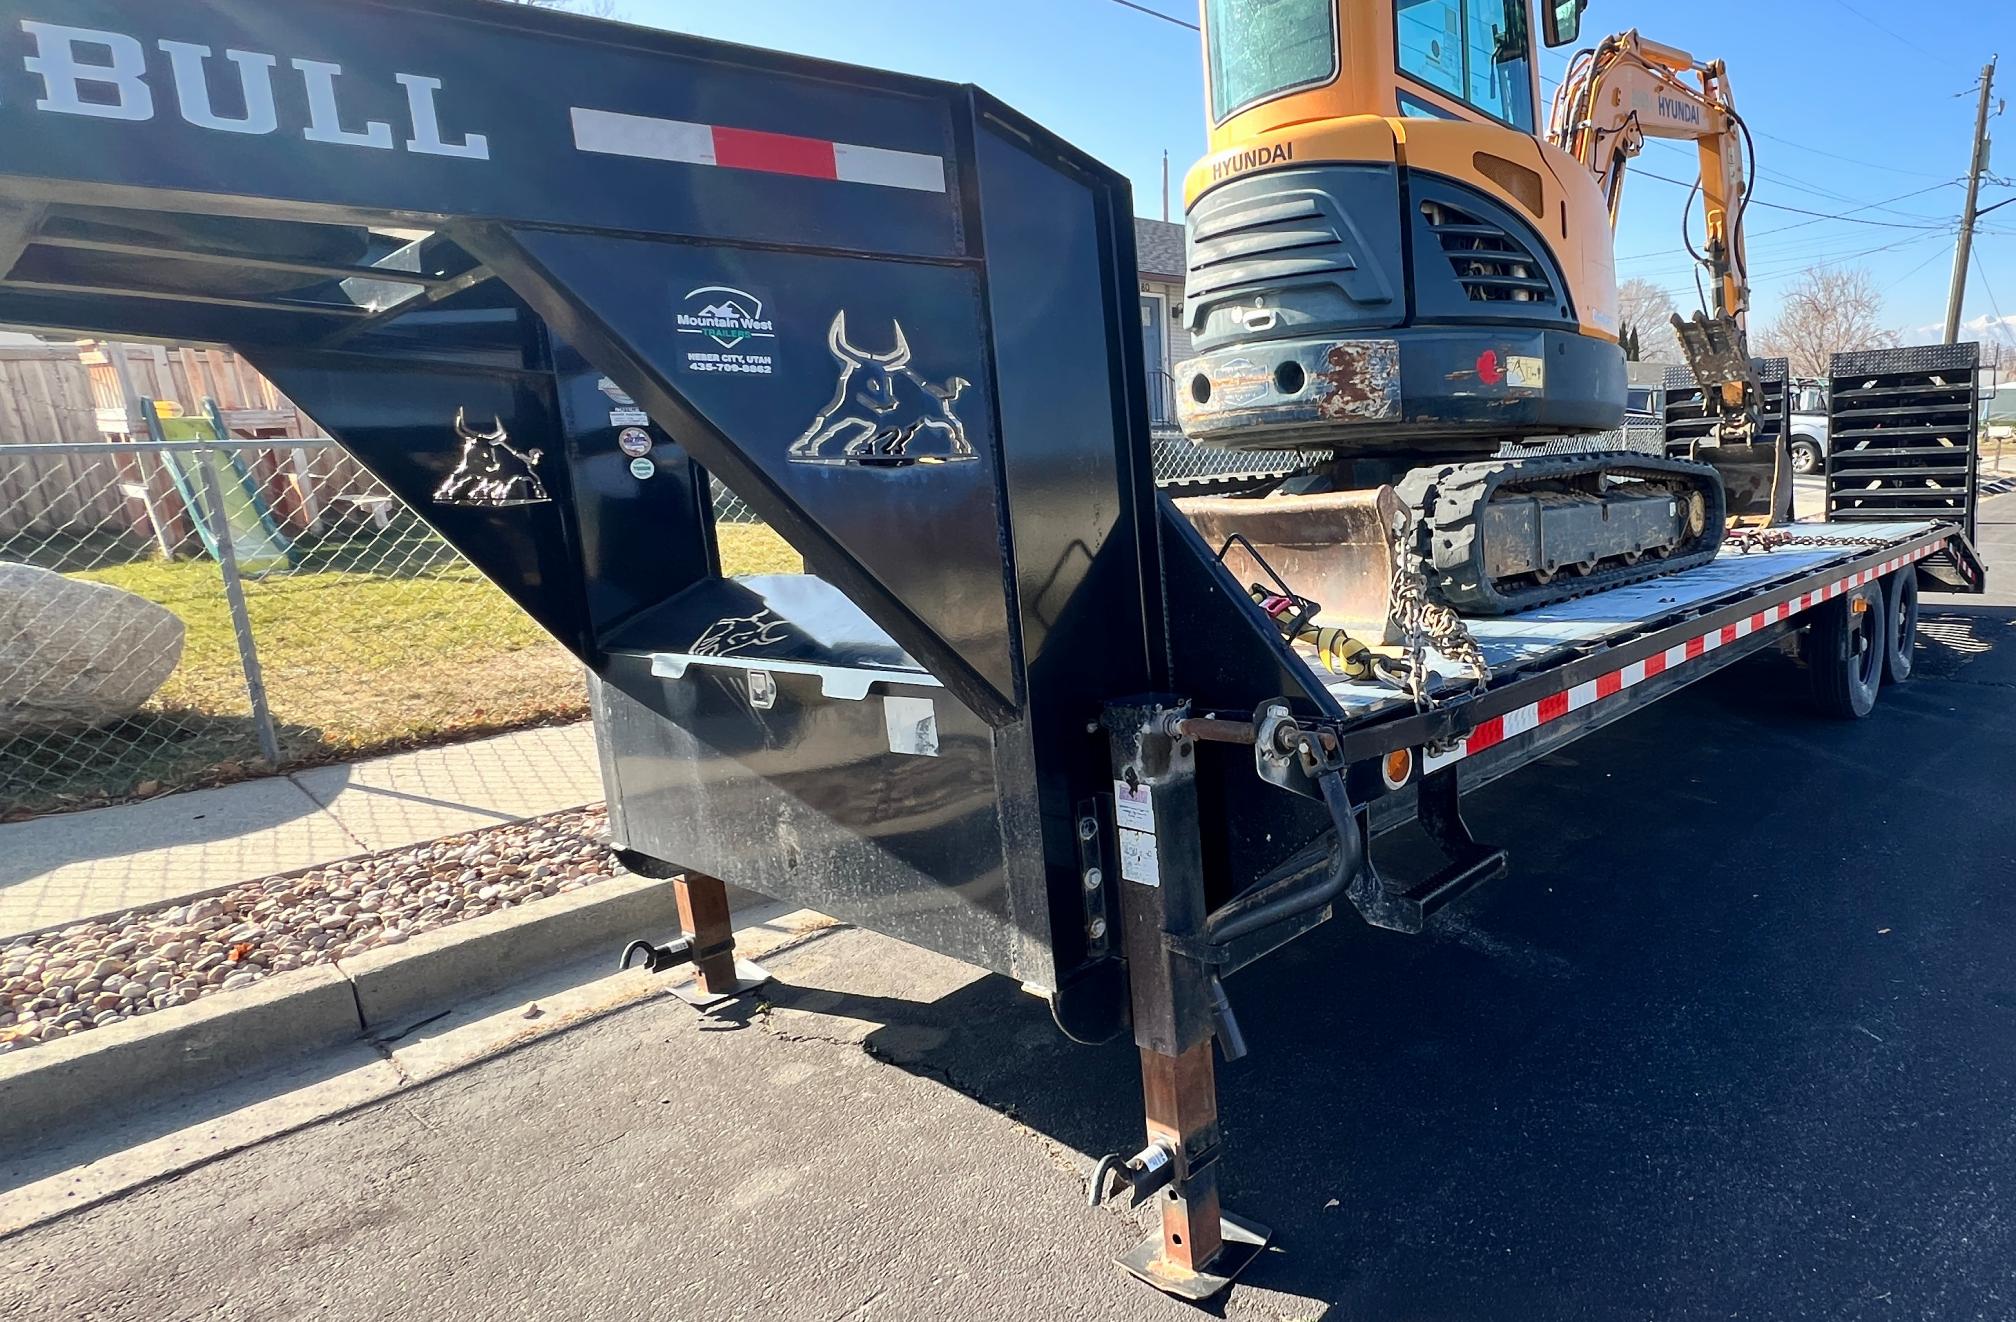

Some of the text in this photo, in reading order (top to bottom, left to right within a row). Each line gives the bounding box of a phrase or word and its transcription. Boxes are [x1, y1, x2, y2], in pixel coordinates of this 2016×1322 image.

[20, 18, 490, 161] BULL
[1658, 96, 1700, 125] HYUNDAI
[1212, 142, 1293, 180] HYUNDAI
[677, 314, 773, 331] Mountain West
[702, 328, 752, 338] TRAILERS
[687, 353, 720, 362] HEBER
[746, 355, 772, 364] UTAH
